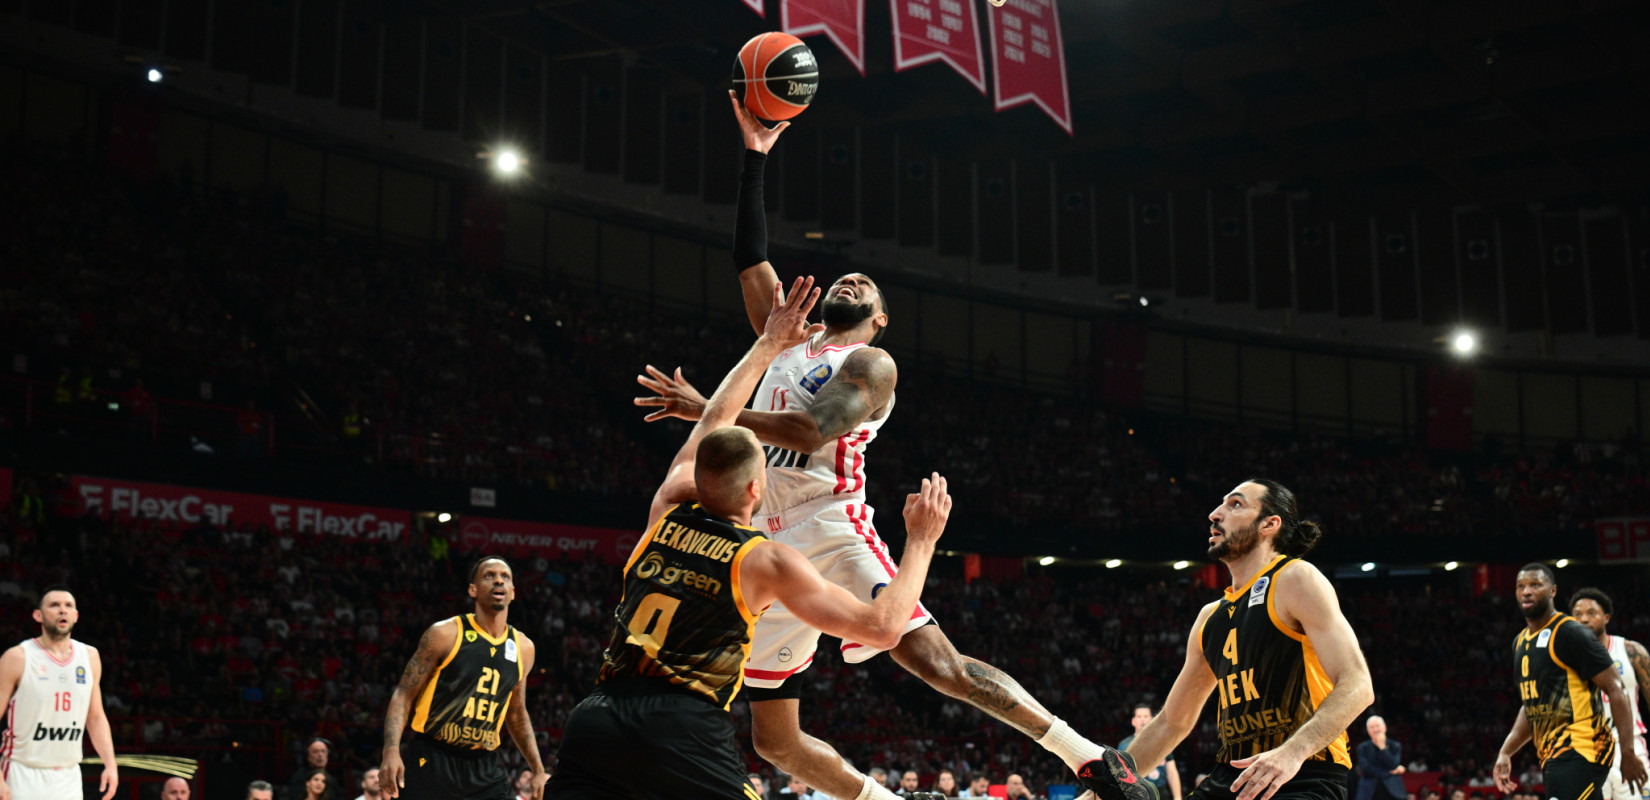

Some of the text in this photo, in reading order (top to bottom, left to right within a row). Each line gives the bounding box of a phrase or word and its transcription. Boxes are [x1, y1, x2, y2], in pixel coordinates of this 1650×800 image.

[110, 487, 234, 525] FlexCar
[296, 506, 405, 541] FlexCar
[768, 516, 782, 531] OLY
[491, 531, 552, 547] NEVER
[557, 537, 598, 550] QUIT
[652, 519, 741, 564] LEKAVICIUS
[659, 566, 722, 596] green
[1222, 628, 1238, 666] 4
[476, 666, 500, 696] 21
[54, 691, 71, 712] 16
[462, 696, 499, 723] AEK
[33, 721, 81, 741] bwin
[461, 726, 497, 743] SUNEL
[1225, 707, 1292, 737] SUNEL
